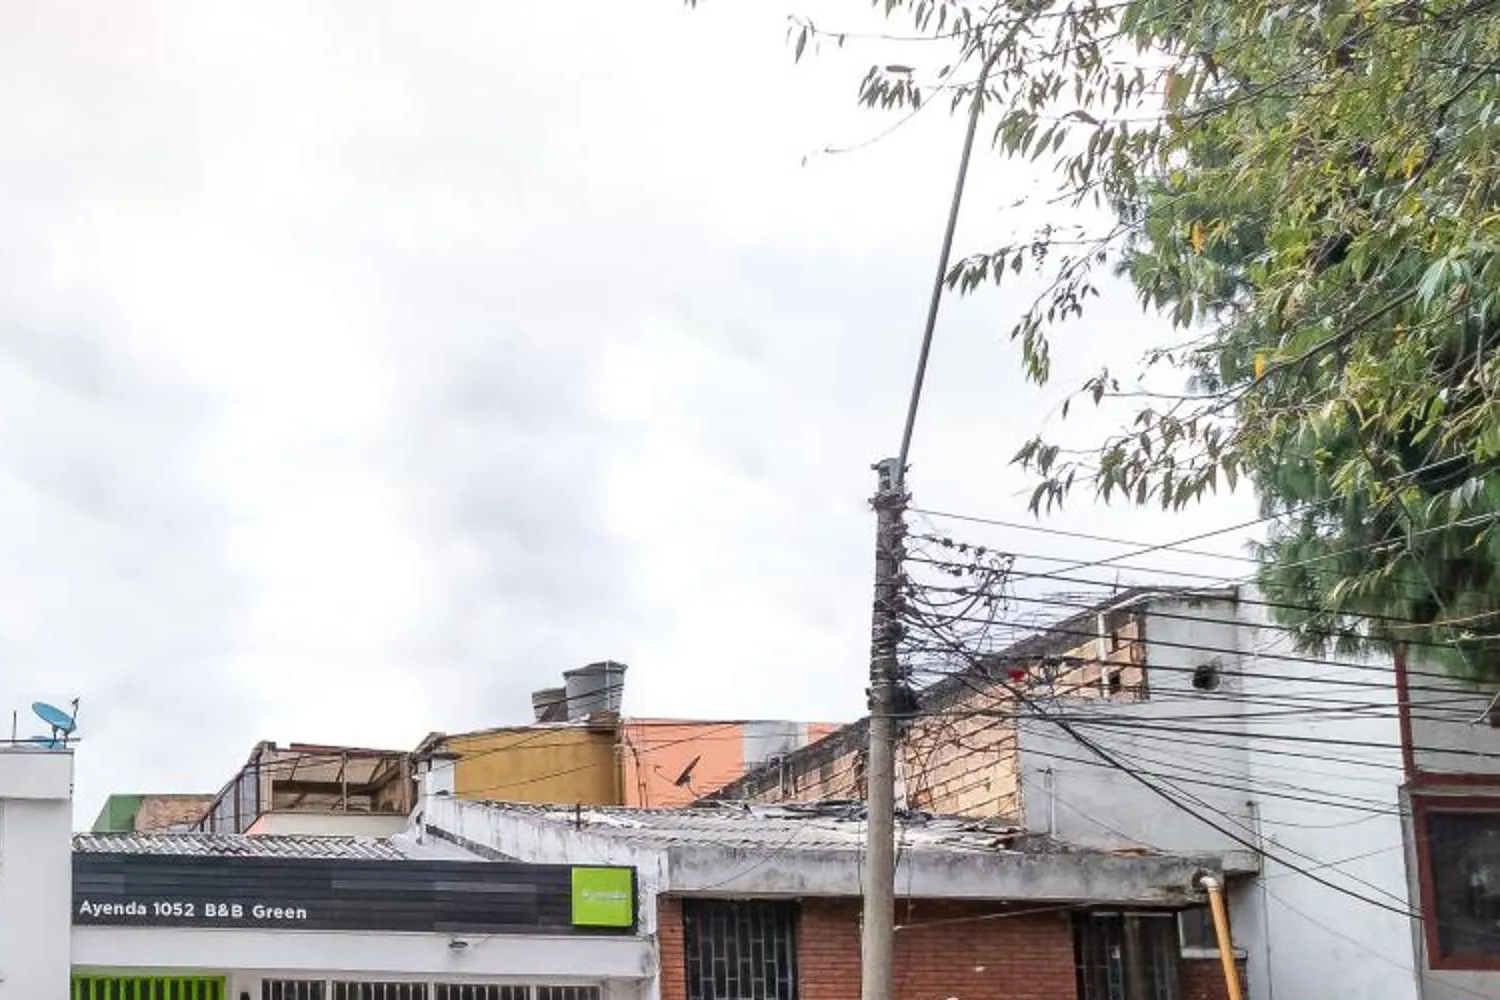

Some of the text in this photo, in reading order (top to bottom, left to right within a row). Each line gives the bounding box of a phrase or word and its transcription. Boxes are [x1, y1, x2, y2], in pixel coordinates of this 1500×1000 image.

[79, 900, 308, 919] Ayenda 1052 B&B Green
